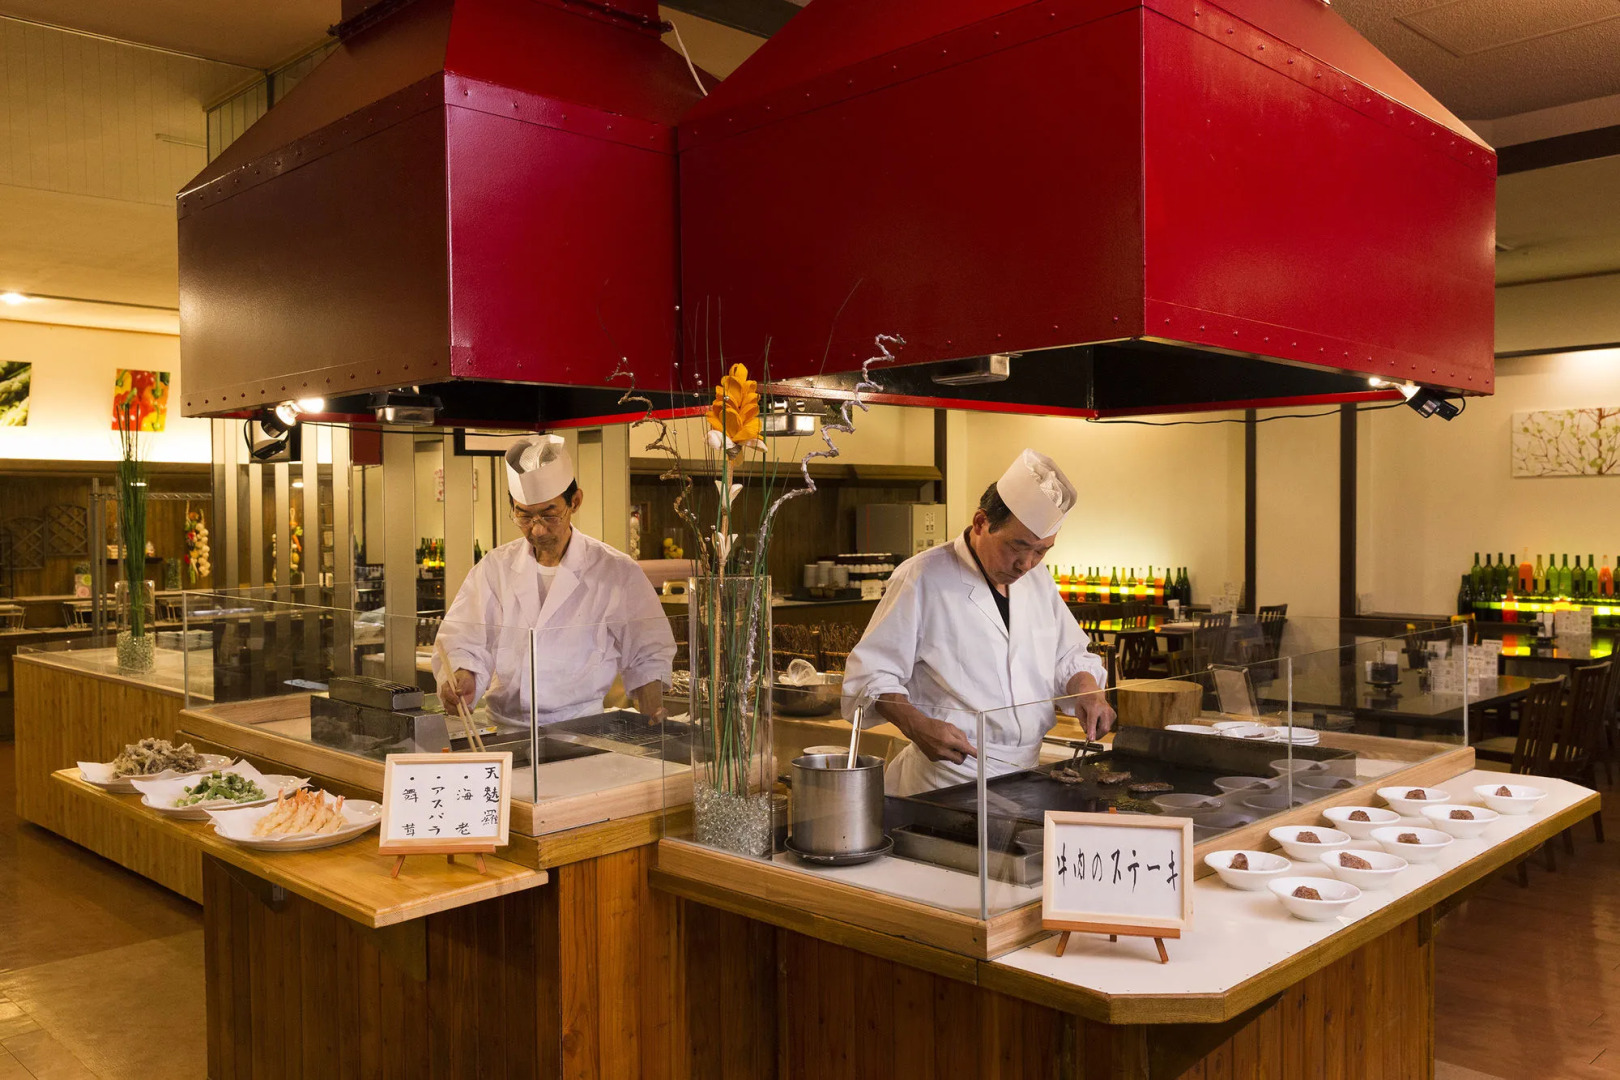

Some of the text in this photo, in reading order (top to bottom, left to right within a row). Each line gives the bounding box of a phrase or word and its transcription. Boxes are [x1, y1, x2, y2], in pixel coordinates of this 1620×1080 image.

[1056, 842, 1179, 893] 牛肉のステーキ
